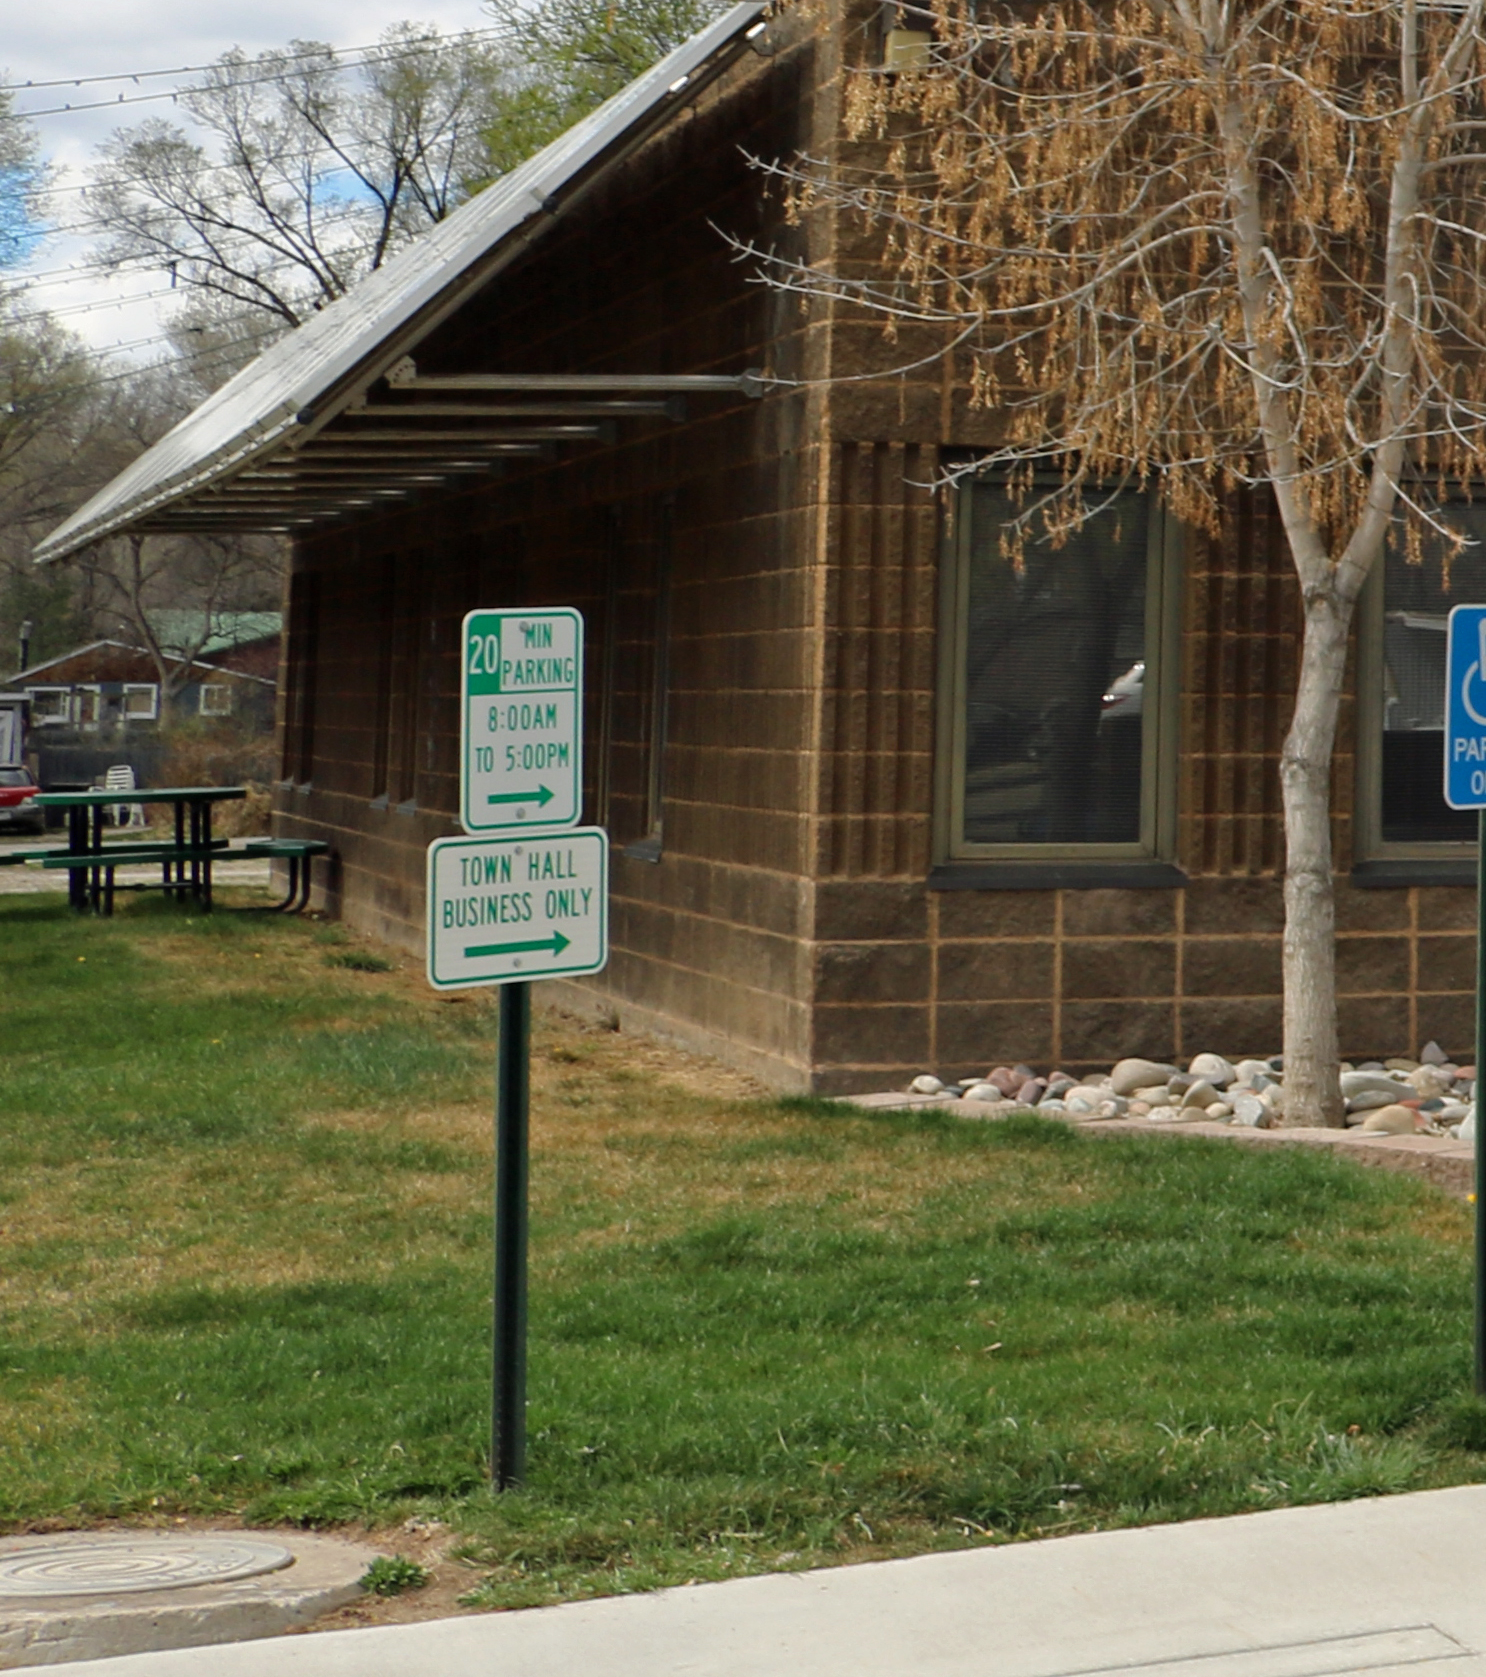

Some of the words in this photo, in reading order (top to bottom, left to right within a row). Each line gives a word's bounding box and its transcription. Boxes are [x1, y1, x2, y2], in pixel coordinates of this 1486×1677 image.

[468, 634, 498, 674] 20
[523, 622, 552, 649] MIN
[502, 657, 574, 686] PARKING
[488, 703, 557, 732] 8:00AM
[475, 745, 494, 773] TO
[505, 742, 569, 772] 5:00PM
[460, 855, 512, 887] TOWN
[528, 850, 577, 881] HALL
[443, 892, 532, 929] BUSINESS
[545, 887, 592, 918] ONLY
